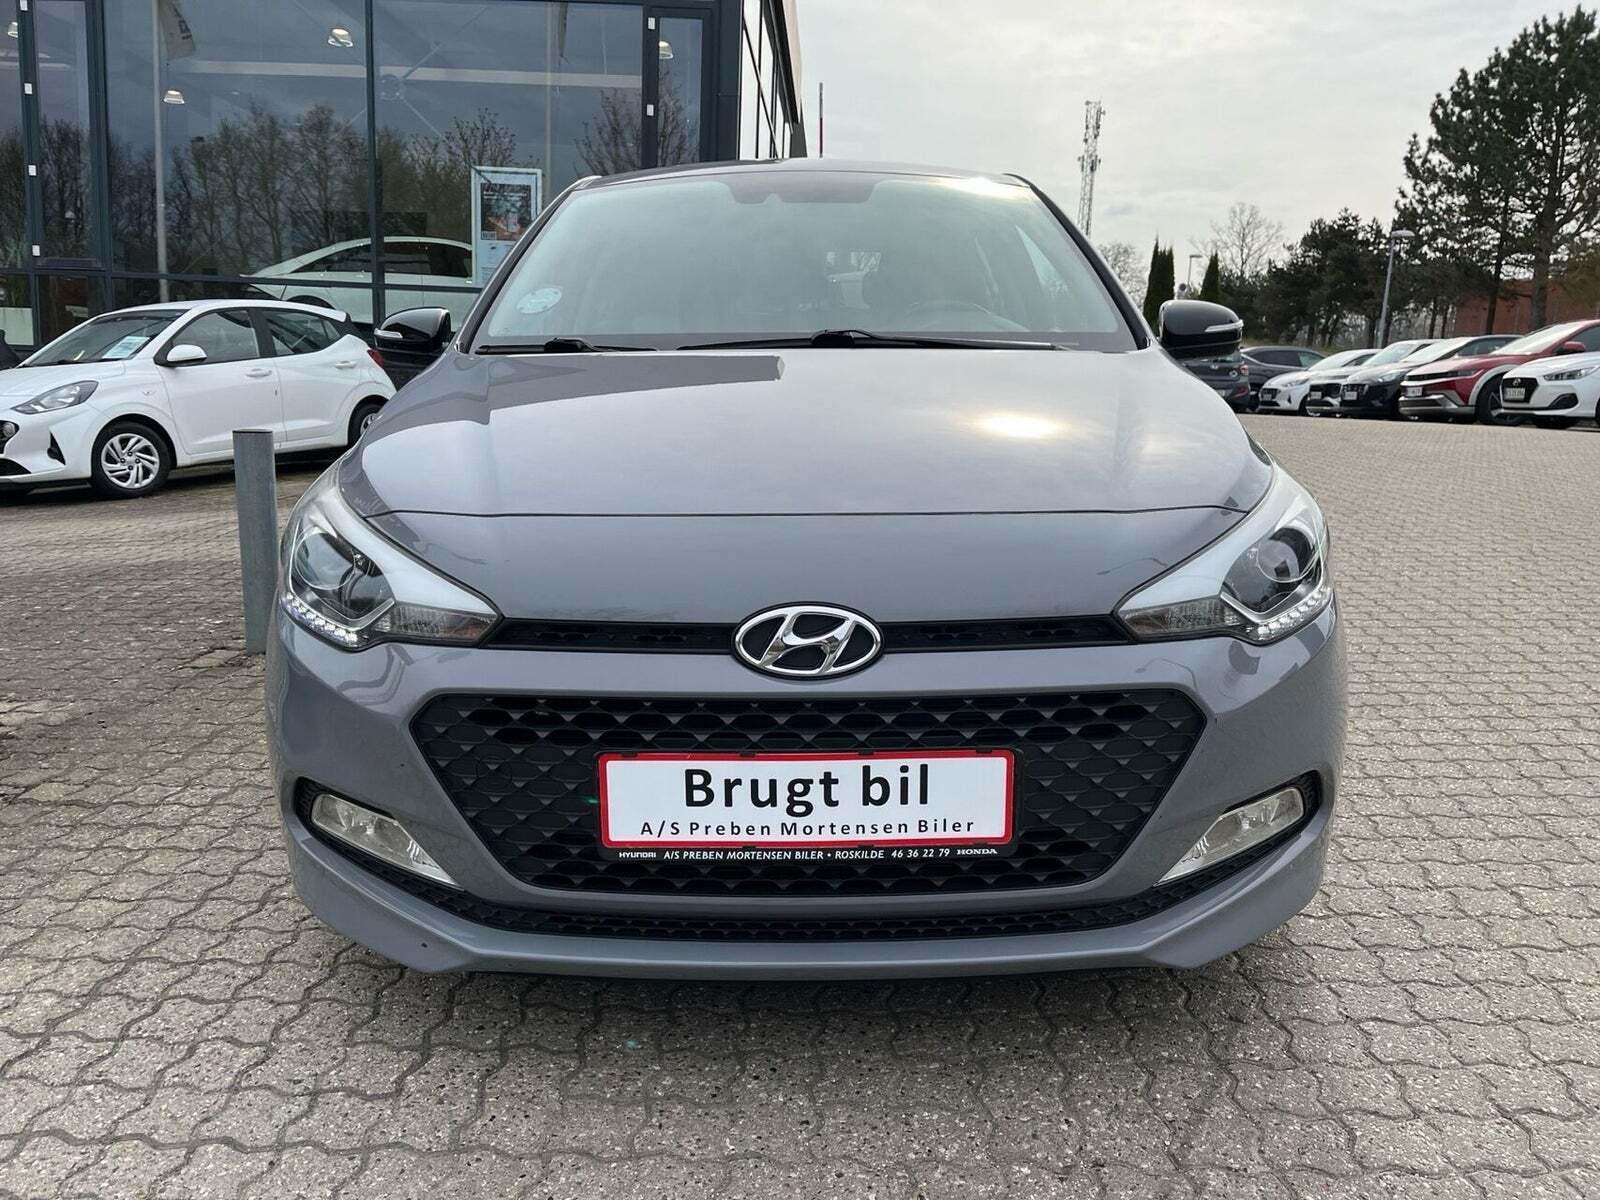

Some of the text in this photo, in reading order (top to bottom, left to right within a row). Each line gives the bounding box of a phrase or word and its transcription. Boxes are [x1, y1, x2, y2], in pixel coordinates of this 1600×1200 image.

[685, 764, 929, 817] Brugt bil
[640, 818, 975, 837] A/S Preben Mortensen Biler
[663, 851, 680, 859] A/S
[682, 851, 724, 860] PREBEN
[726, 851, 791, 860] MORTENSEN
[794, 851, 824, 860] BILER
[834, 850, 885, 860] ROSKILDE
[891, 849, 904, 859] 46
[907, 849, 919, 859] 36
[923, 849, 934, 858] 22
[938, 848, 950, 857] 79
[956, 848, 998, 856] HONDA
